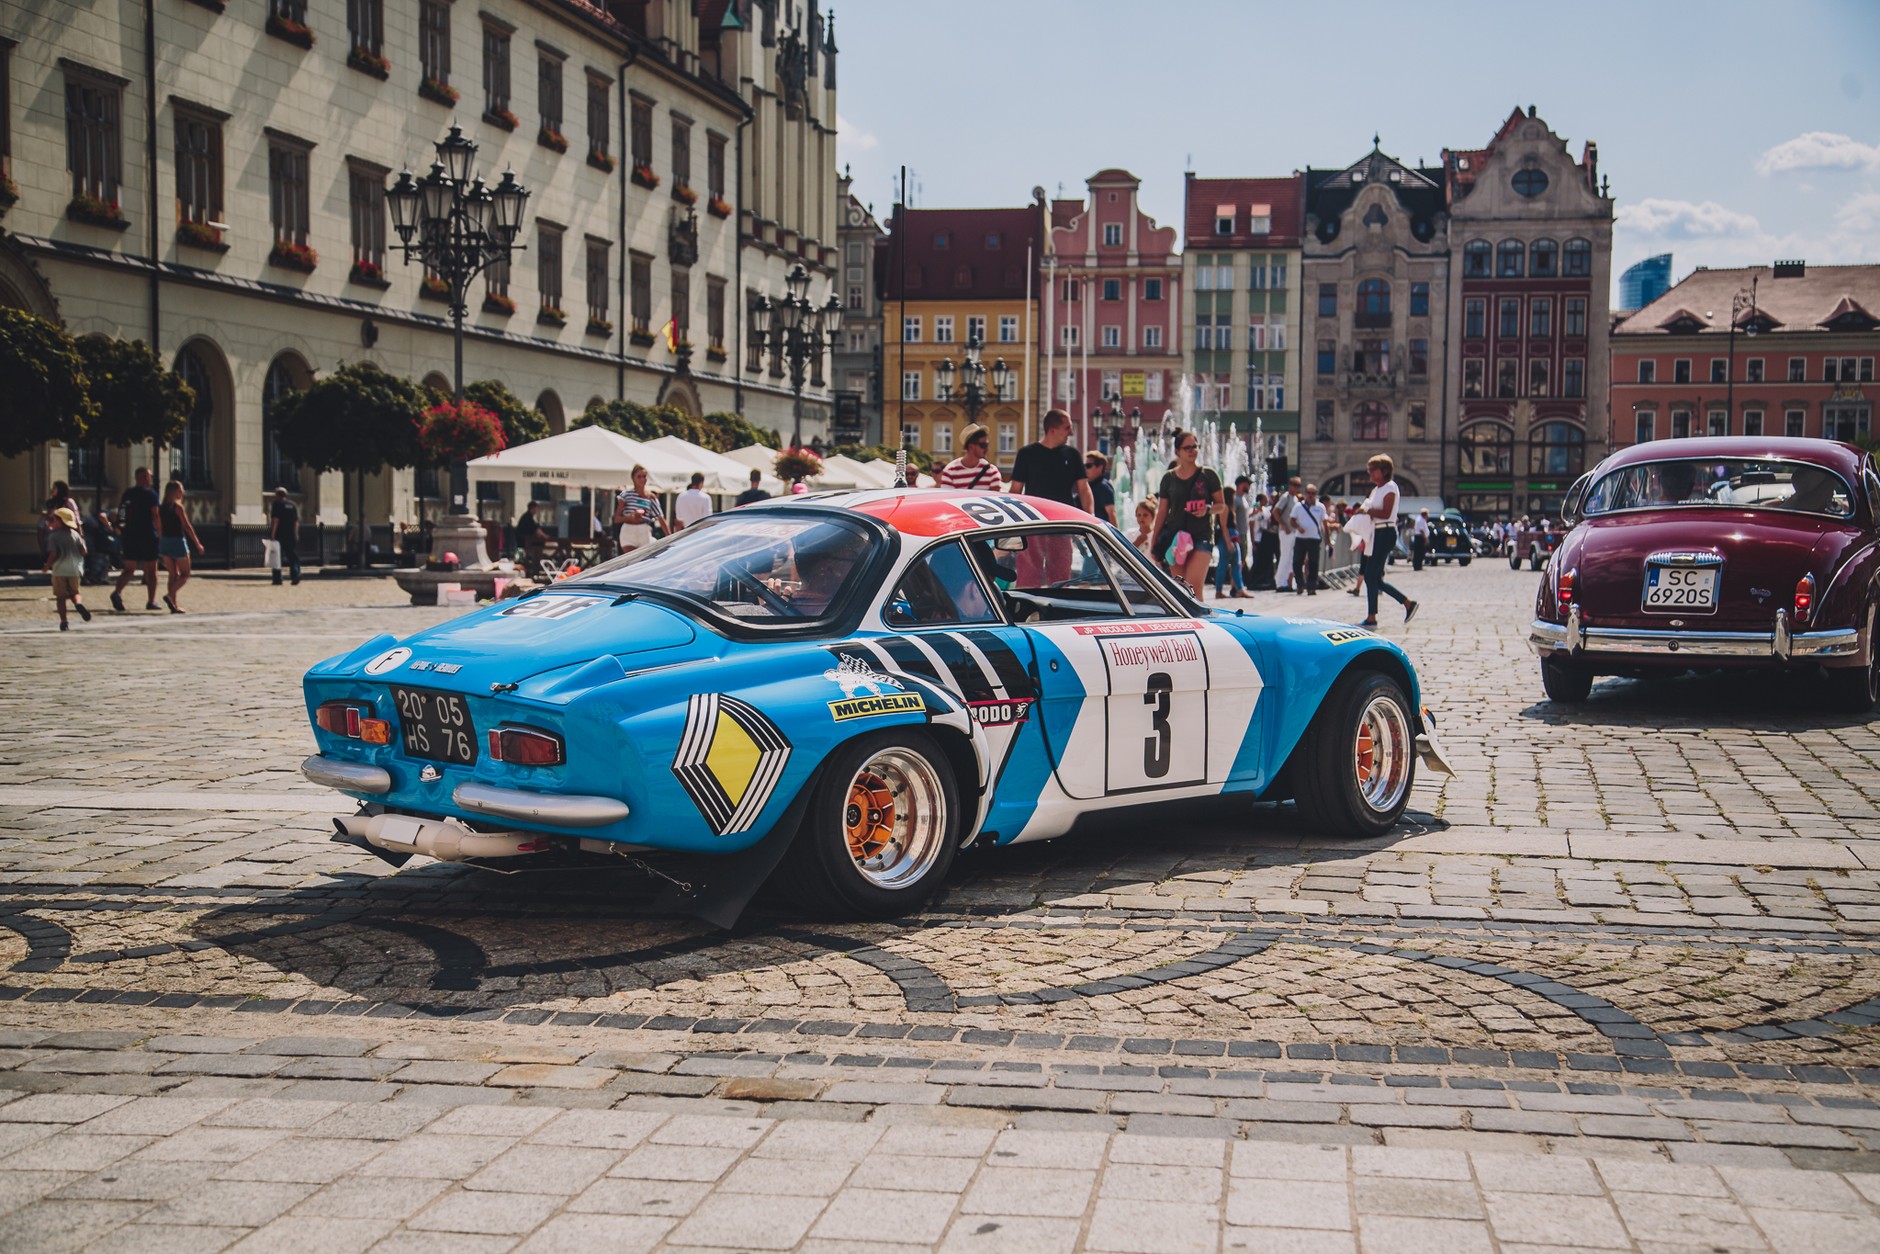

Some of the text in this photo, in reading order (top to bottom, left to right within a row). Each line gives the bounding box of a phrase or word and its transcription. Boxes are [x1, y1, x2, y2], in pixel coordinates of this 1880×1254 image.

[961, 496, 1041, 525] elf
[1668, 570, 1698, 586] SC
[1650, 587, 1711, 605] 6920S
[502, 597, 606, 619] elf
[1083, 626, 1095, 635] JP
[374, 651, 403, 671] F
[1109, 638, 1198, 671] Honeywell Bull
[436, 695, 464, 727] 05
[834, 697, 920, 717] MICHELIN
[1143, 672, 1172, 779] 3
[406, 723, 471, 760] HS 76
